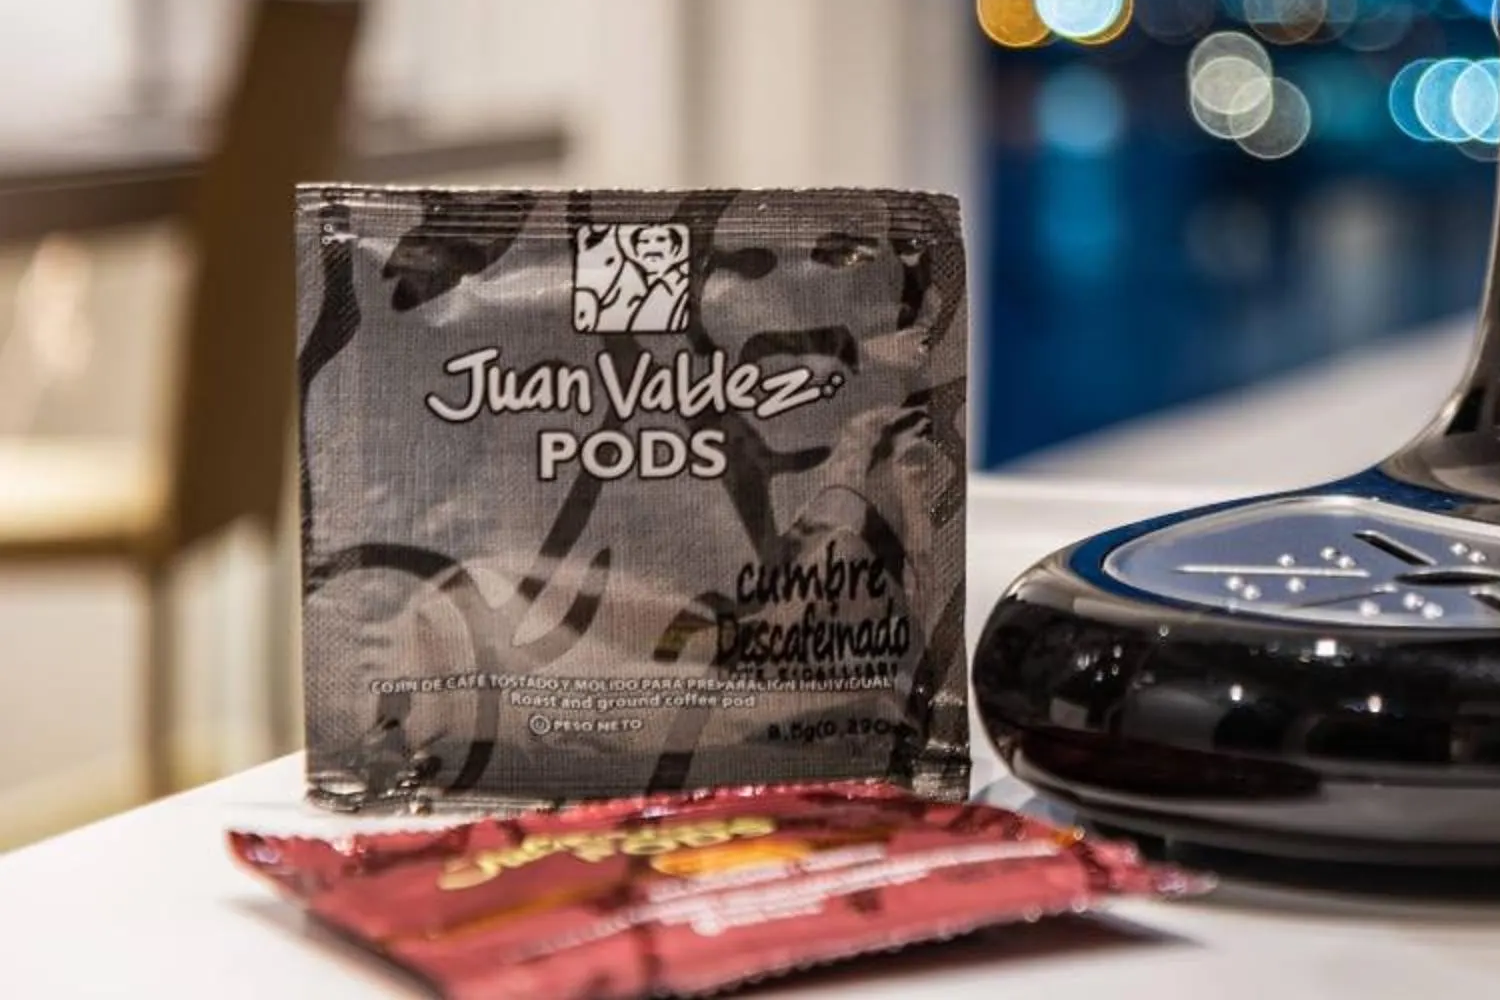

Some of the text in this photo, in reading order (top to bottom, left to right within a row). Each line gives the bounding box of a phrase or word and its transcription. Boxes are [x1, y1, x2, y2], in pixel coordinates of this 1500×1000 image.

[426, 346, 822, 422] Juan Valdez
[536, 429, 728, 480] PODS
[736, 540, 888, 604] cumbre
[421, 678, 443, 693] DE
[574, 678, 640, 692] MOLIDO
[642, 679, 683, 692] PARA
[511, 690, 757, 712] Roast and ground coffee pod
[553, 717, 643, 732] PESO NETO
